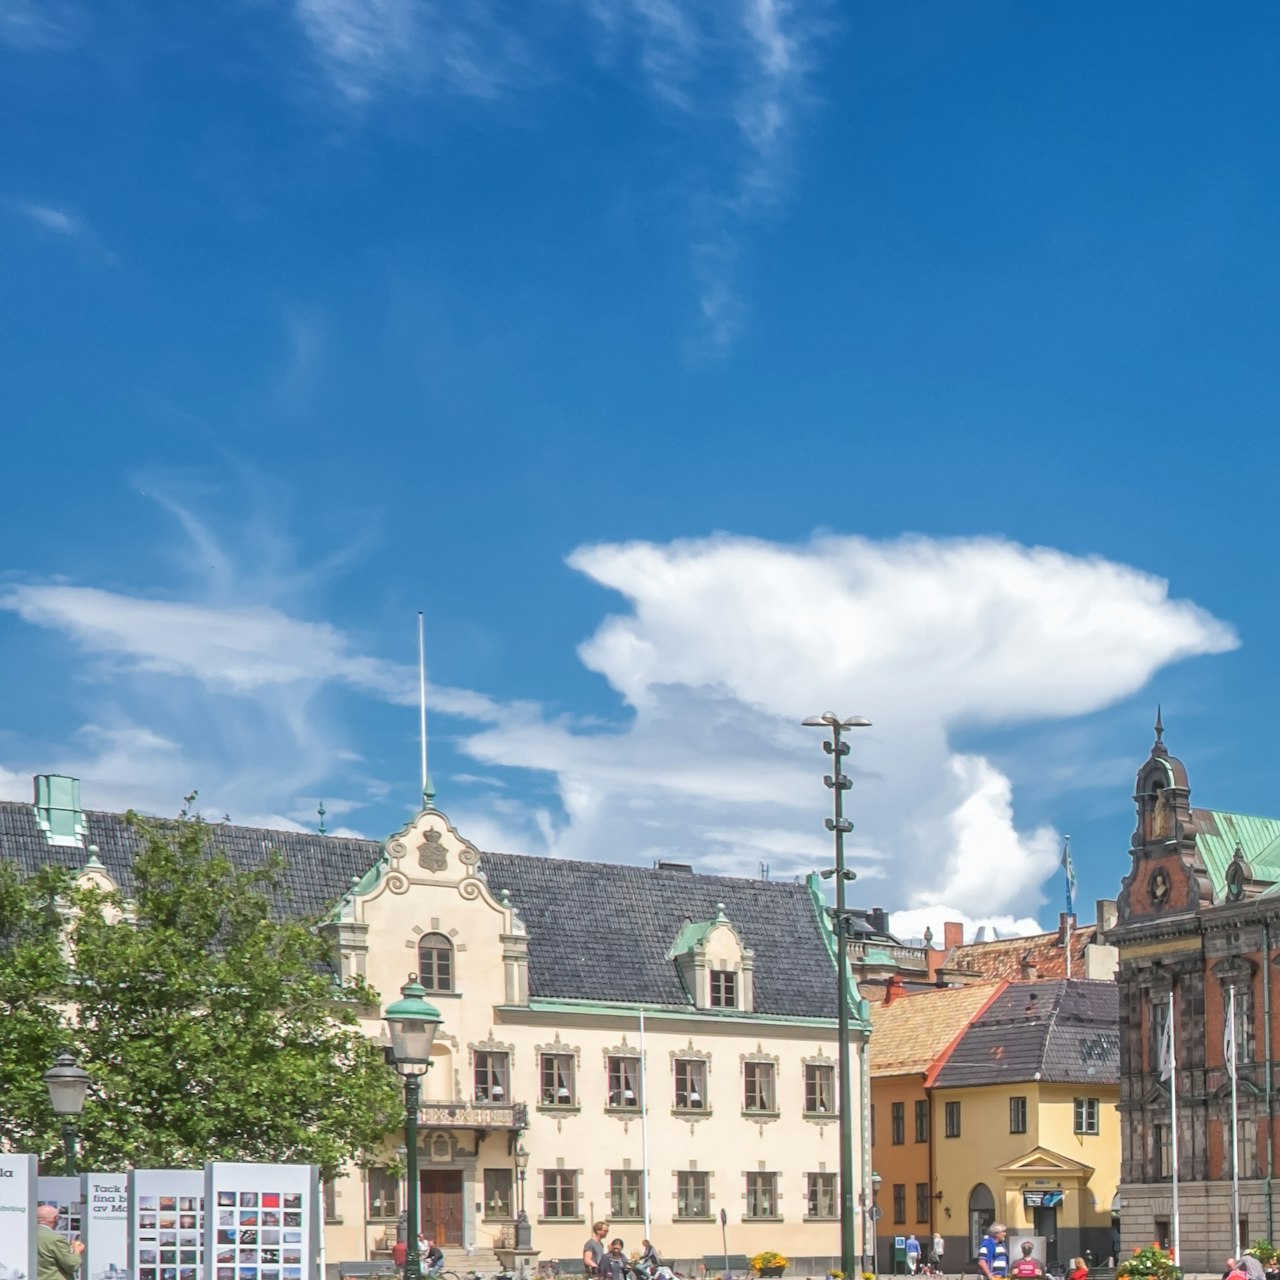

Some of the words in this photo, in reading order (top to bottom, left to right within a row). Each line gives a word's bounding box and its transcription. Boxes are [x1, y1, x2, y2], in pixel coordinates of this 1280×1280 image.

[93, 1184, 121, 1193] Tack
[93, 1195, 116, 1203] fina
[93, 1205, 108, 1213] av
